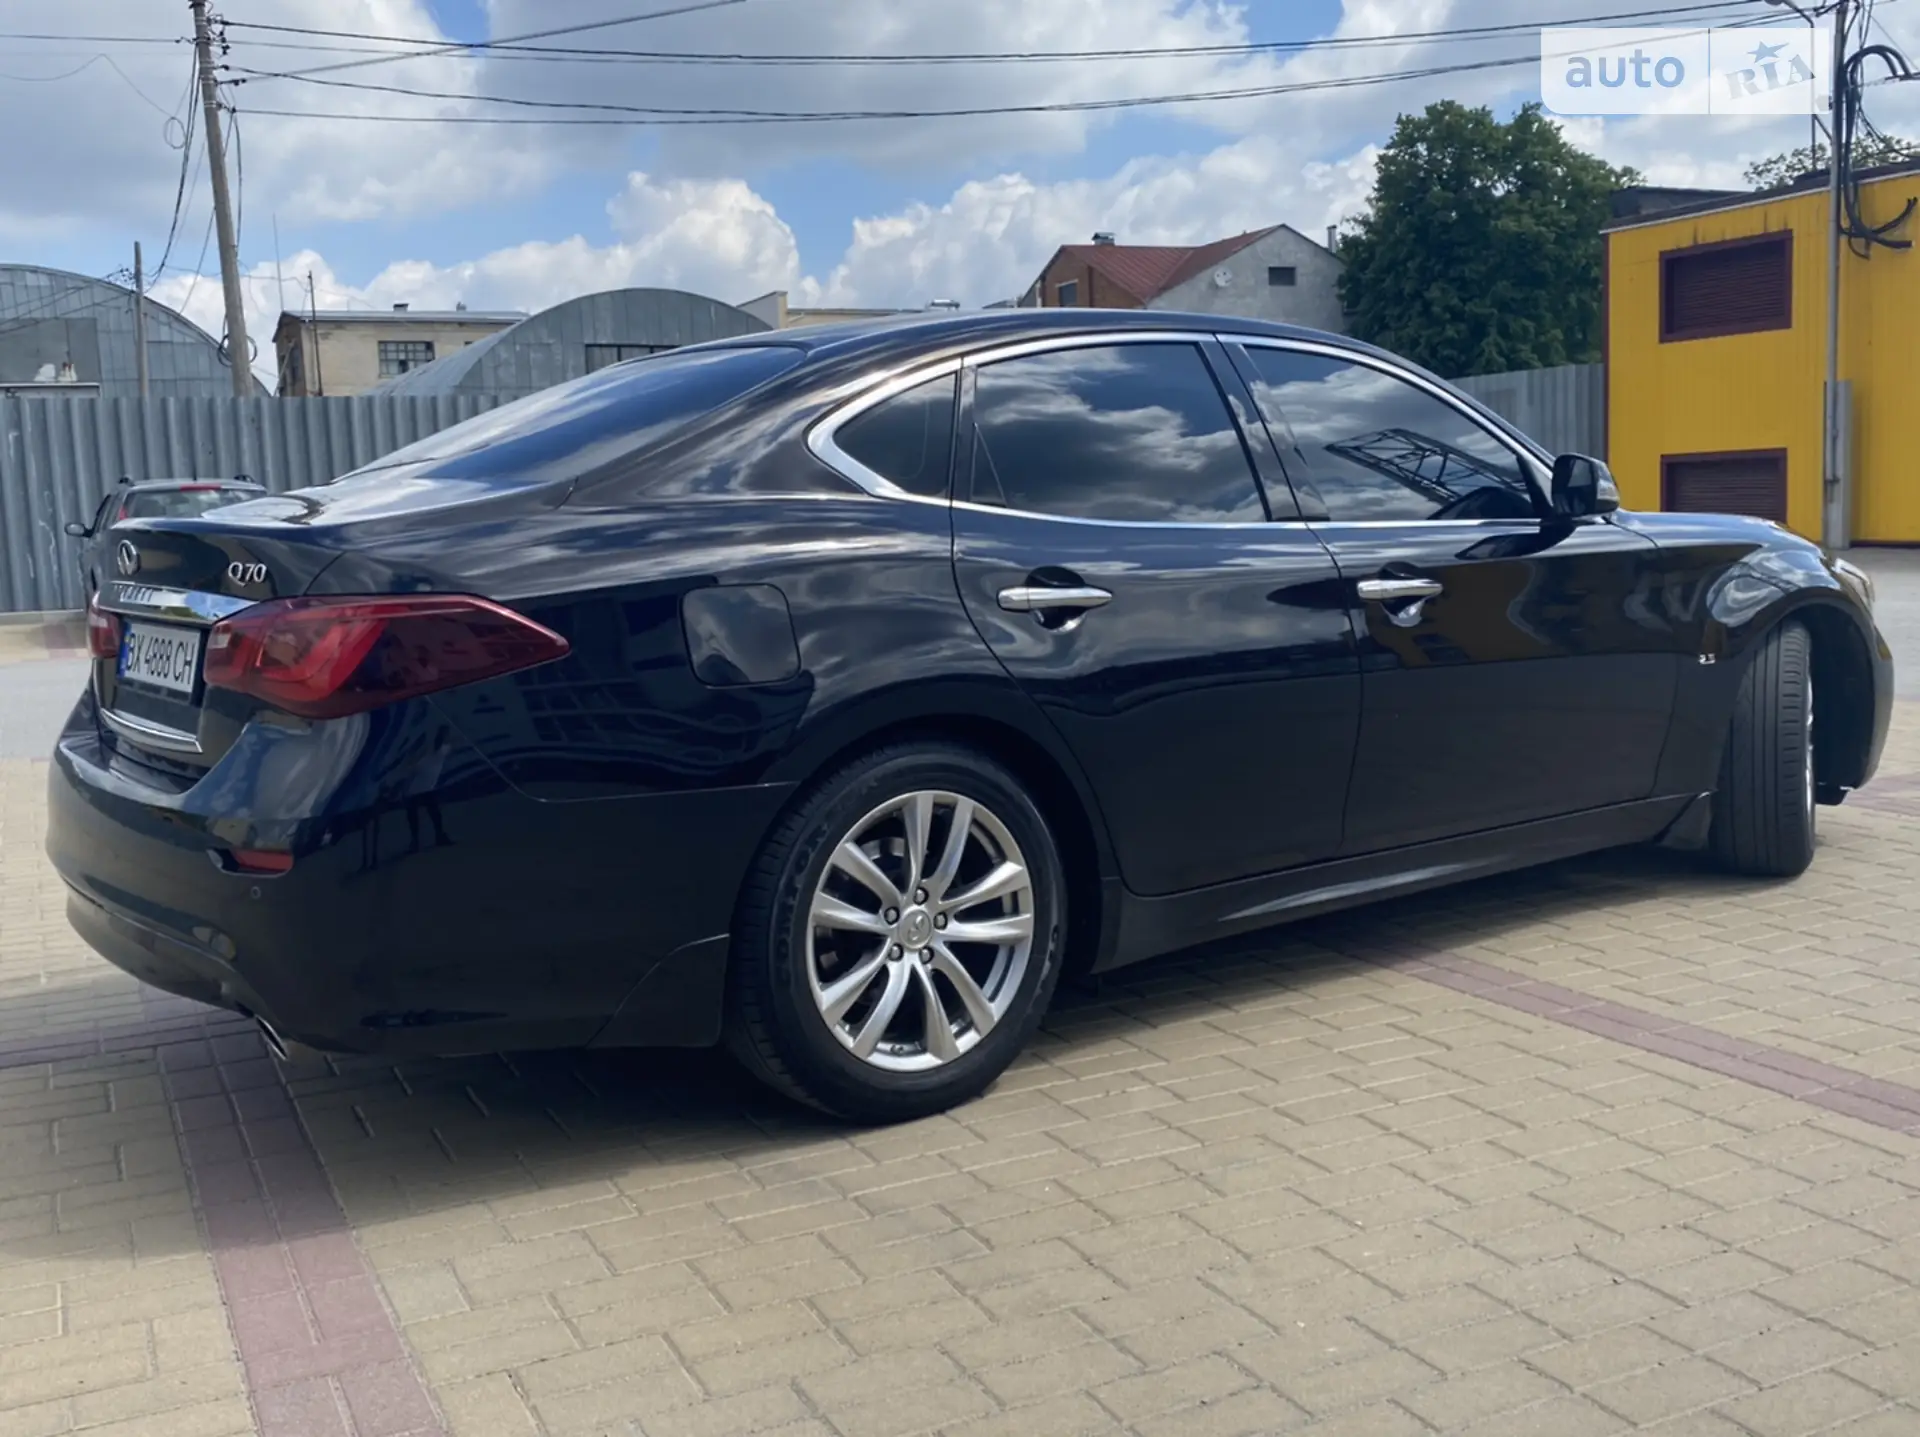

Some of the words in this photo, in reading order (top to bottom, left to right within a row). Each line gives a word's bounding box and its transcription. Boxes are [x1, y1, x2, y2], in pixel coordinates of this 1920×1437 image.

[227, 561, 267, 587] Q70
[126, 632, 145, 674] BX
[145, 636, 173, 679] 4888
[173, 640, 196, 685] CH
